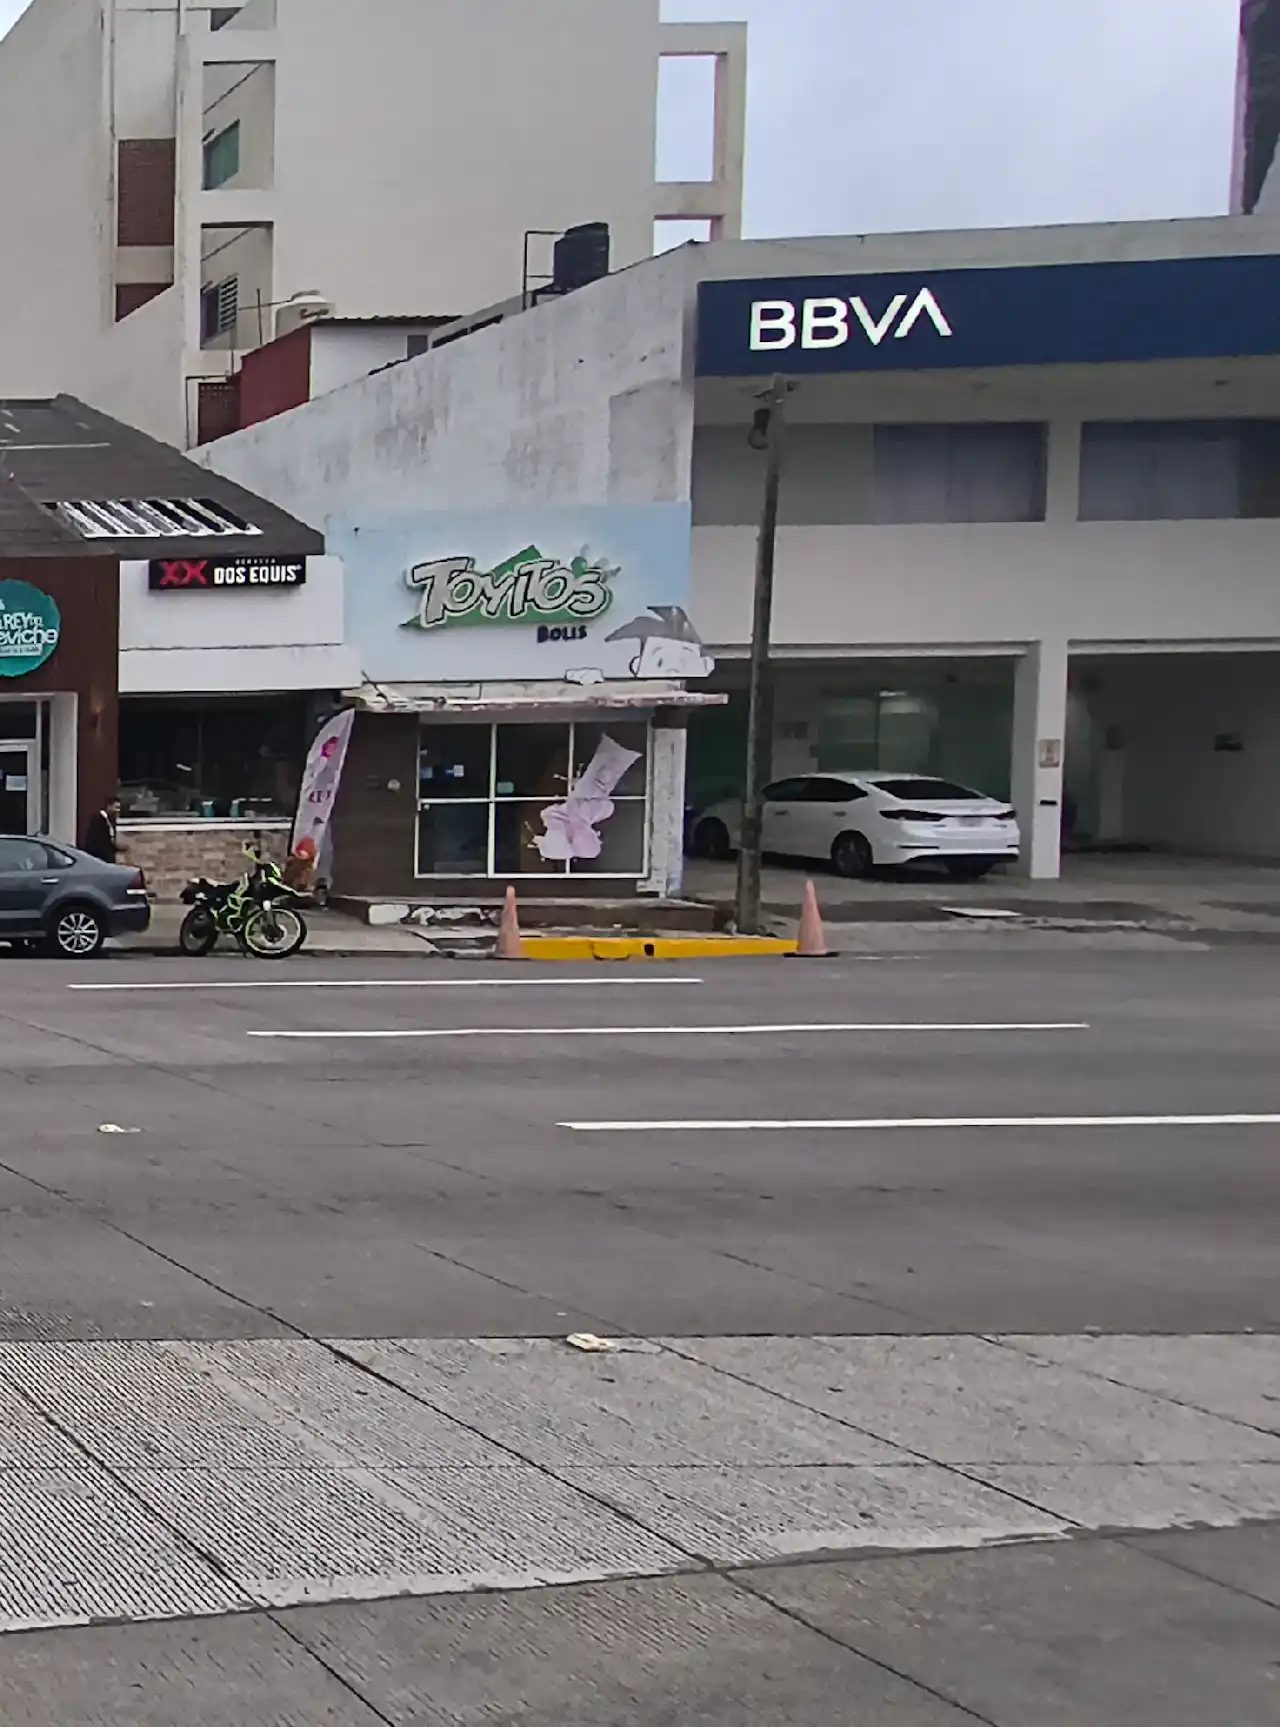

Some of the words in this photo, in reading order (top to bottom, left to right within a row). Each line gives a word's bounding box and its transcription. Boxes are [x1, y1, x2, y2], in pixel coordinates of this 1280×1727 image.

[749, 287, 953, 350] BBVA
[159, 560, 208, 585] XX
[214, 567, 246, 584] DOS
[249, 565, 297, 584] EQUIS
[3, 612, 34, 630] REY
[537, 625, 587, 643] BOLIS
